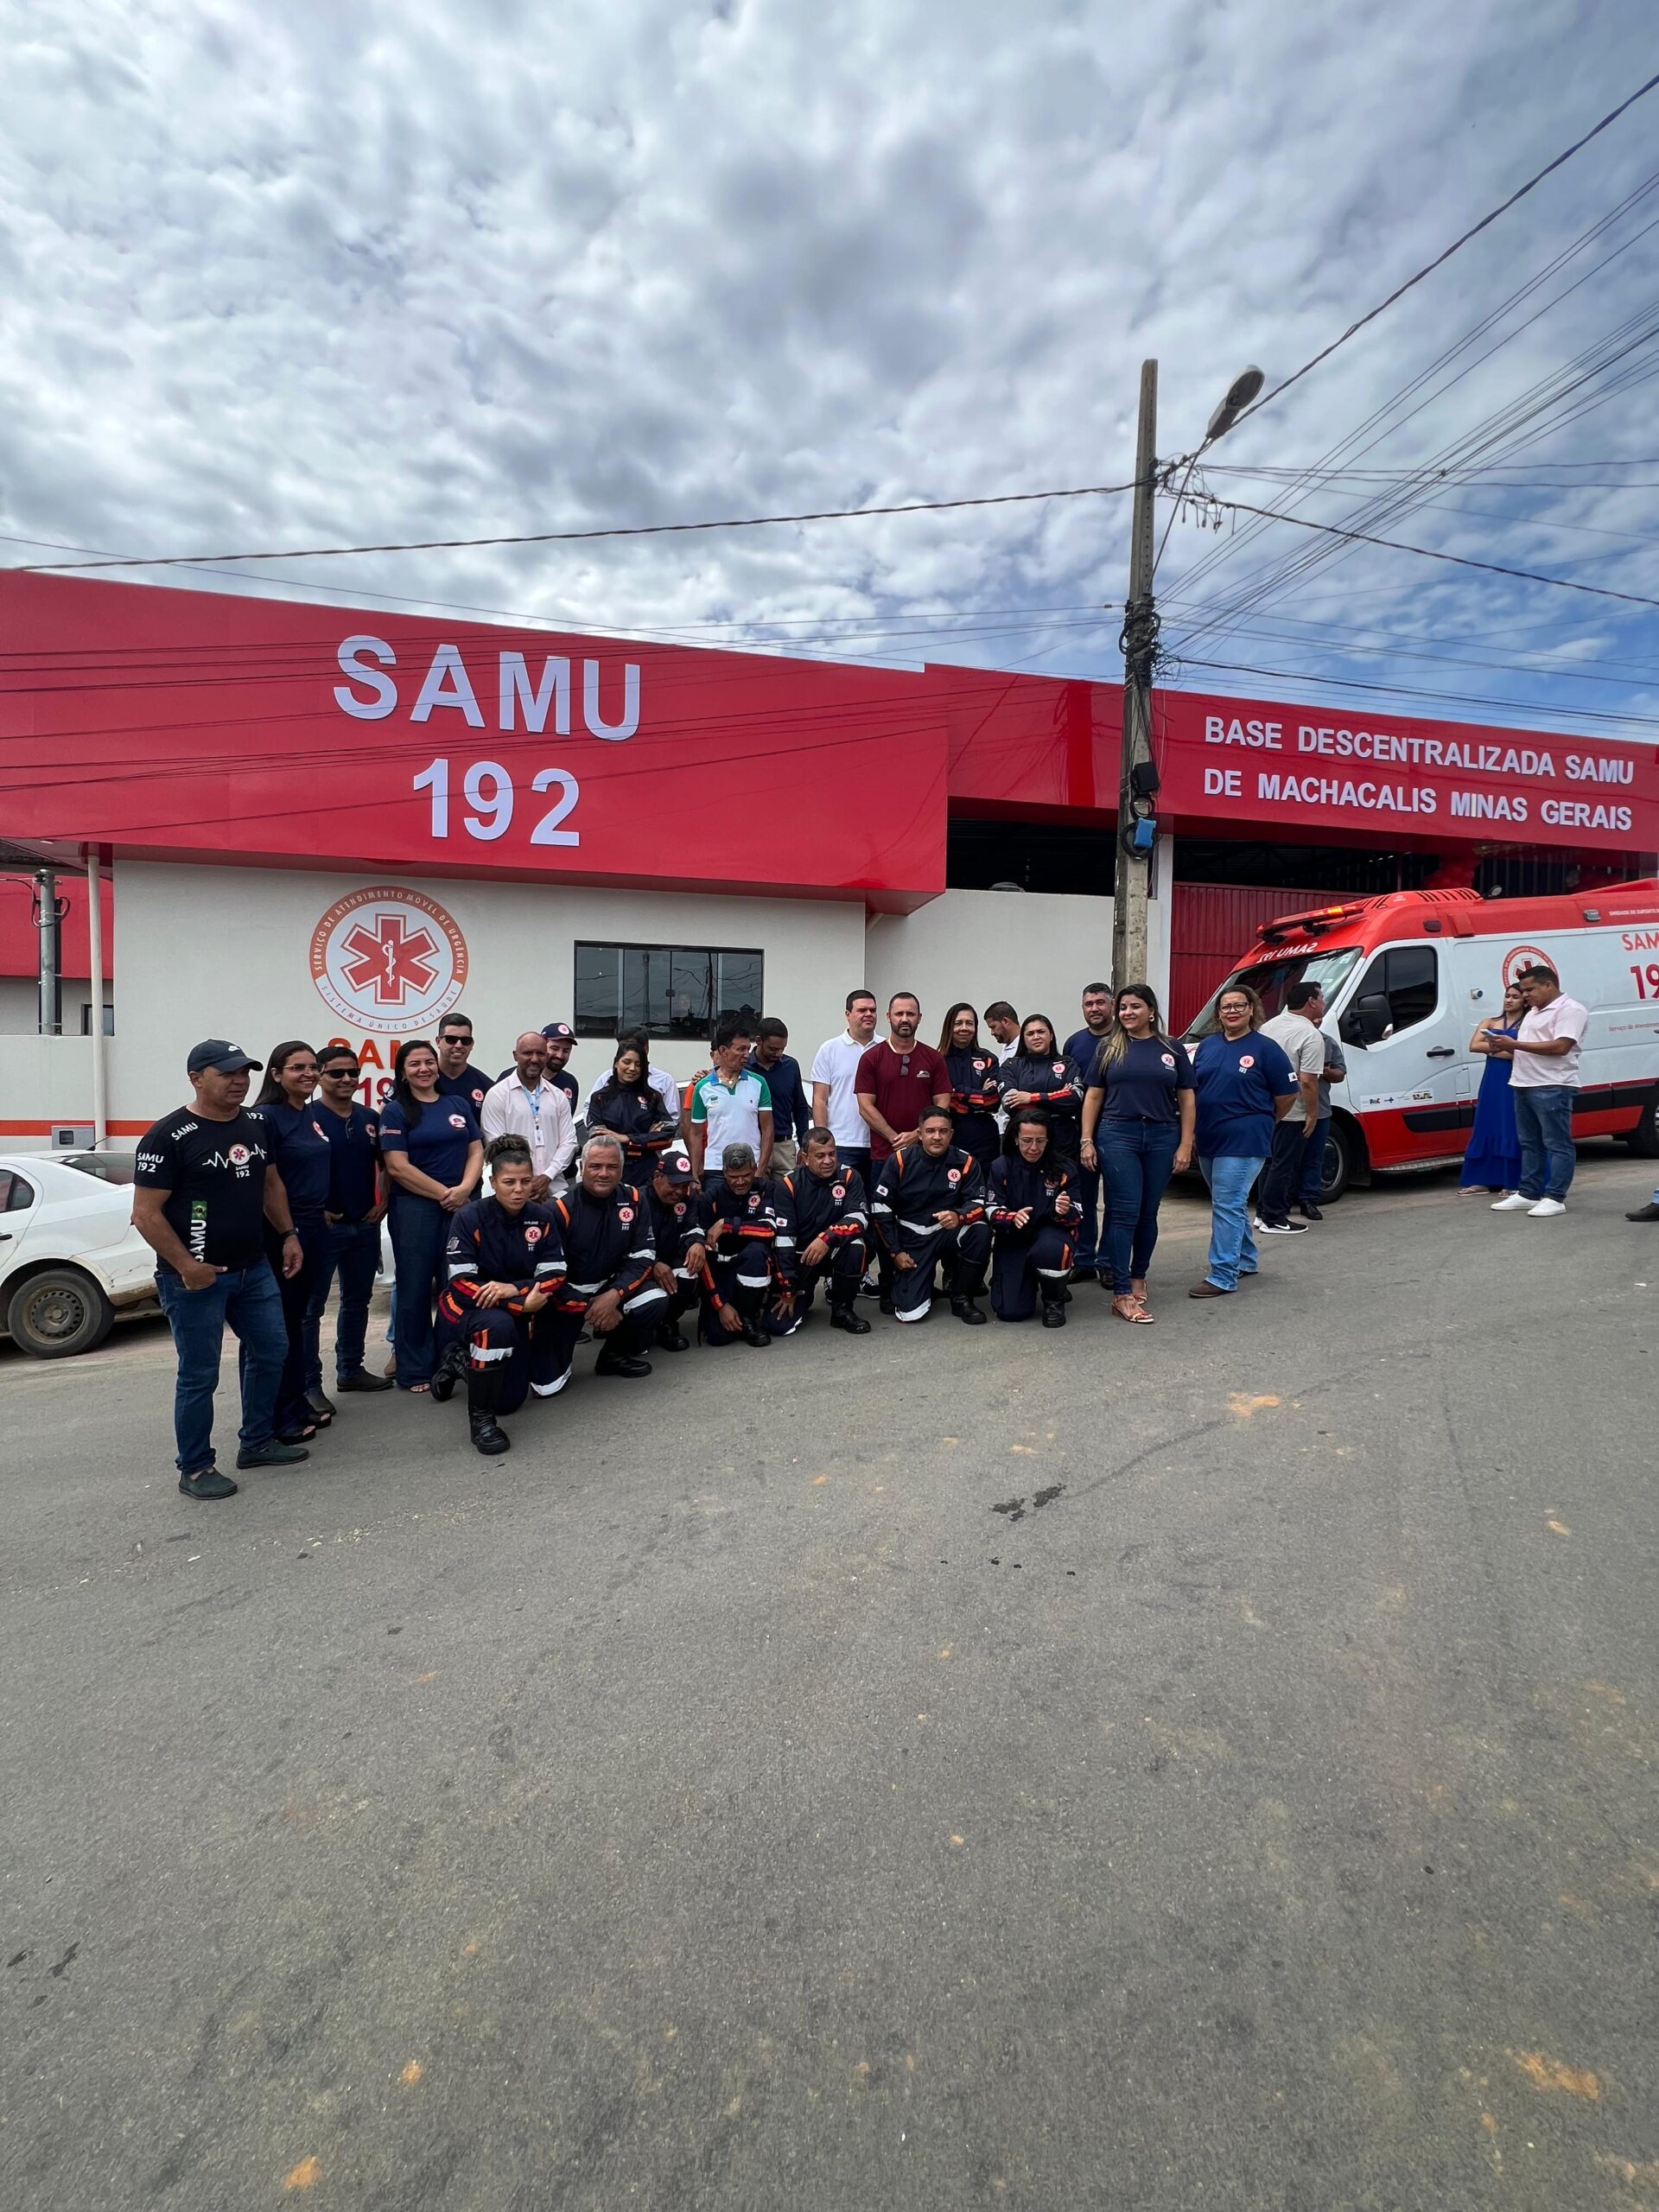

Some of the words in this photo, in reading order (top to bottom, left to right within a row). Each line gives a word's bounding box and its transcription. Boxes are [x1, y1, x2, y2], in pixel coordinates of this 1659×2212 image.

[334, 635, 640, 741] SAMU
[1205, 715, 1282, 749] BASE
[1298, 726, 1555, 777] DESCENTRALIZADA
[1564, 754, 1635, 785] SAMU
[413, 758, 580, 847] 192
[1204, 768, 1242, 797] DE
[1257, 772, 1437, 813] MACHACALIS
[1450, 791, 1529, 822] MINAS
[1540, 799, 1632, 830] GERAIS
[314, 931, 327, 971] SERVIÇO
[323, 916, 335, 928] DE
[334, 890, 403, 916] ATENDIMENTO
[438, 914, 450, 926] DE
[171, 1122, 199, 1141] SAMU
[245, 1112, 264, 1121] 192
[137, 1152, 164, 1164] SAMU
[137, 1161, 156, 1173] 192
[235, 1169, 251, 1179] 192
